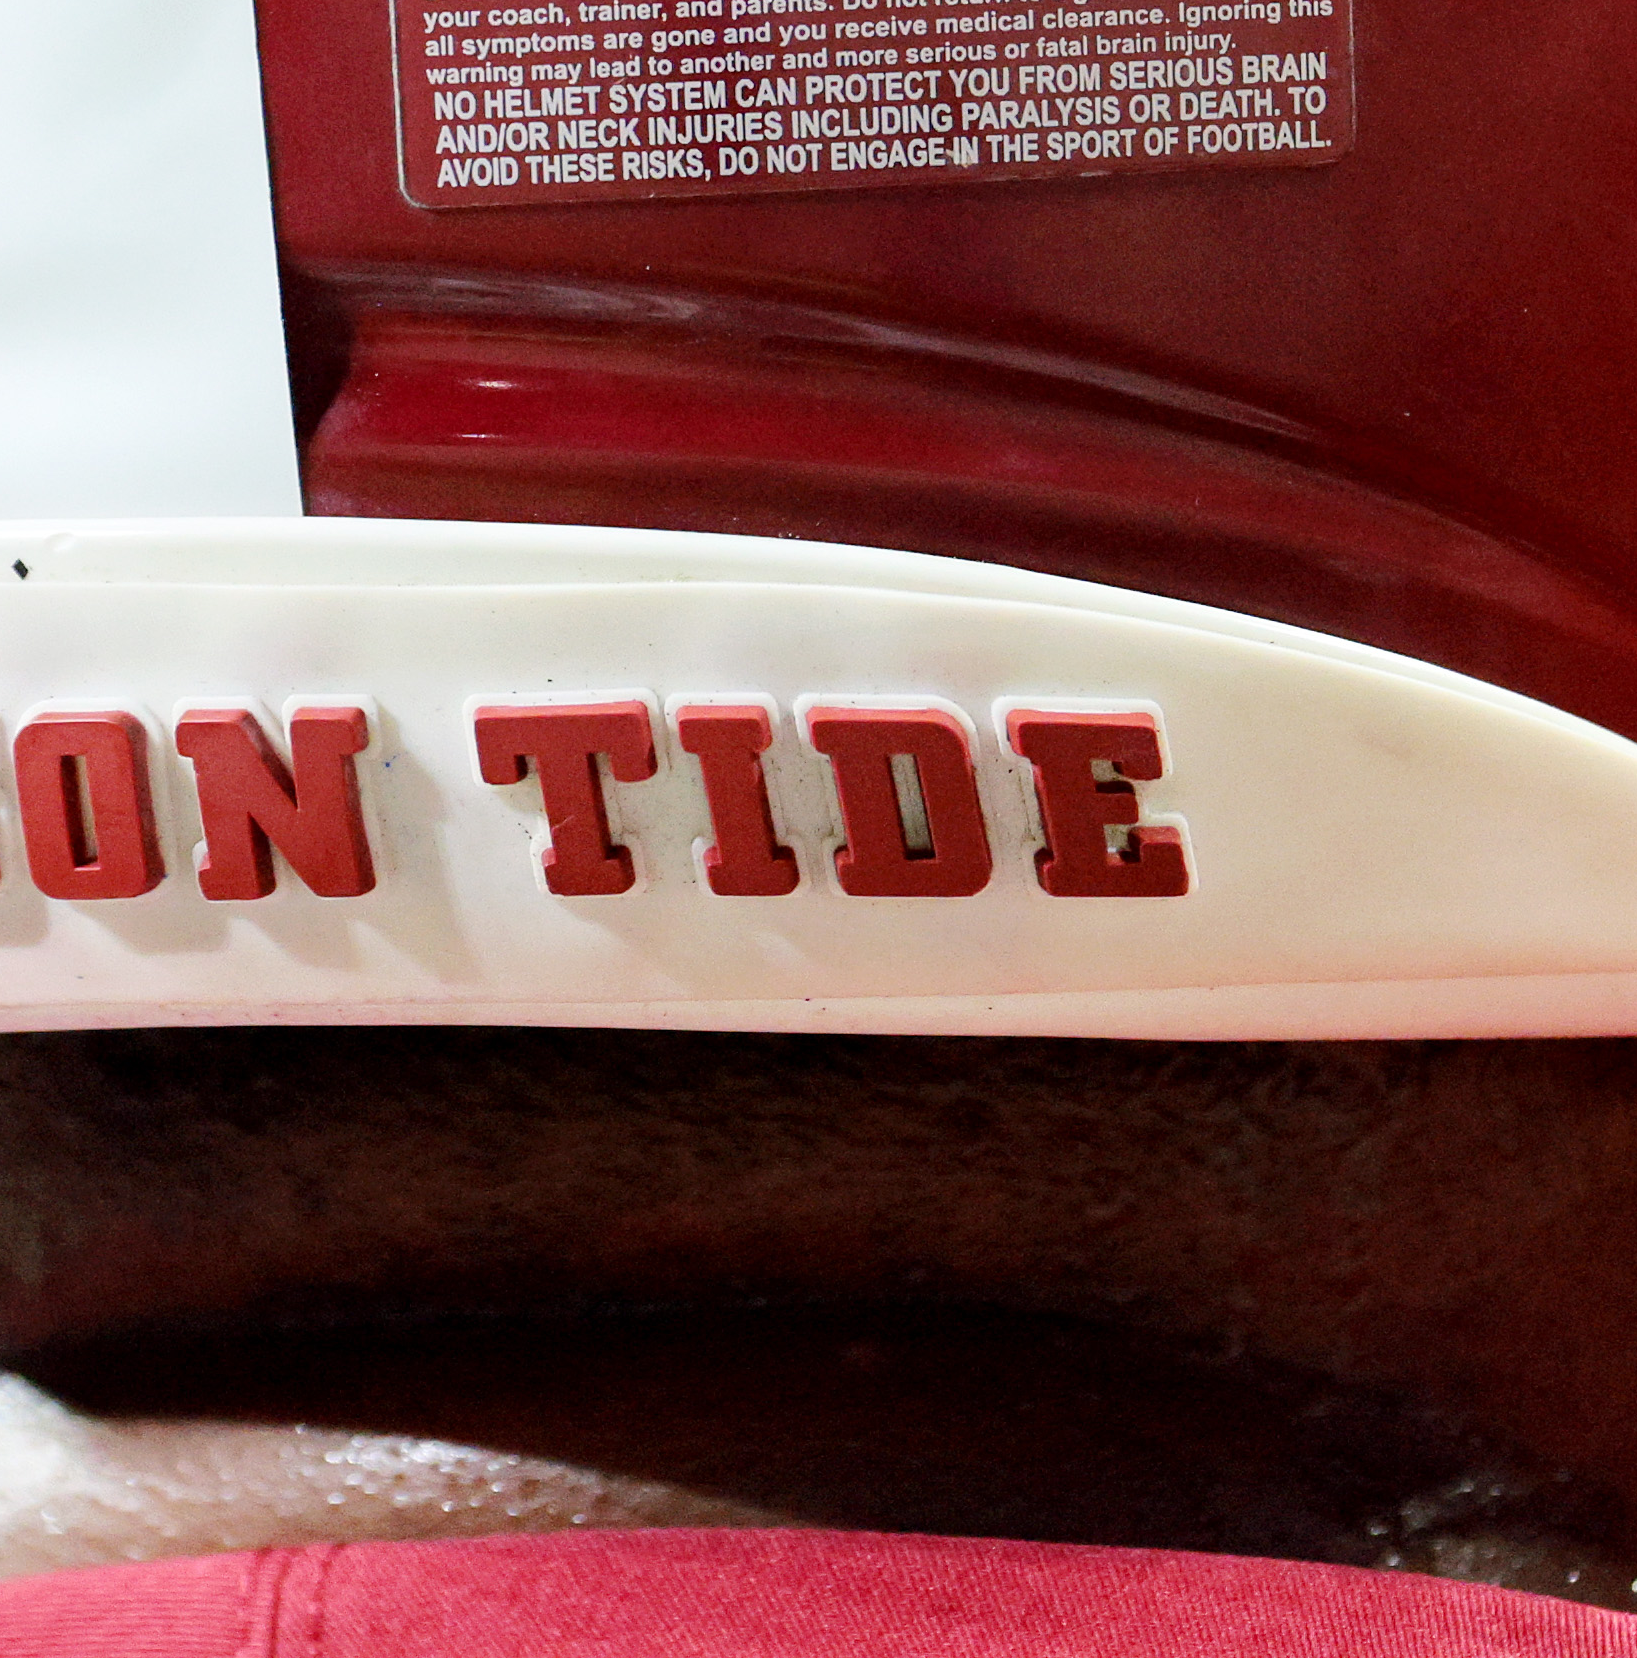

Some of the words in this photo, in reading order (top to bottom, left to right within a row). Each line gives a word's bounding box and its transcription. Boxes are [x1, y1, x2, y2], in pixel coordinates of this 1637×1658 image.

[422, 10, 481, 34] your
[487, 2, 571, 27] coach,
[577, 0, 668, 23] trainer,
[424, 34, 455, 57] all
[461, 32, 596, 60] symptoms
[602, 31, 644, 50] are
[650, 28, 716, 53] gone
[722, 20, 772, 45] and
[778, 23, 827, 47] you
[834, 14, 928, 39] receive
[935, 9, 1035, 34] medical
[1042, 7, 1171, 30] clearance.
[425, 61, 524, 88] warning
[530, 62, 583, 85] may
[589, 54, 641, 79] lead
[647, 55, 673, 77] to
[679, 50, 776, 75] another
[782, 47, 828, 70] and
[835, 48, 899, 68] more
[905, 41, 997, 65] serious
[1004, 42, 1031, 60] or
[1035, 34, 1088, 58] fatal
[1096, 32, 1157, 55] brain
[1164, 29, 1237, 57] injury.
[433, 90, 477, 121] NO
[483, 85, 602, 119] HELMET
[608, 79, 727, 115] SYSTEM
[734, 76, 797, 108] CAN
[805, 69, 942, 105] PROTECT
[947, 66, 1010, 98] YOU
[1018, 62, 1101, 95] FROM
[1109, 56, 1234, 91] SERIOUS
[1241, 51, 1327, 85] BRAIN
[435, 121, 551, 155] AND/OR
[557, 117, 642, 150] NECK
[647, 110, 784, 146] INJURIES
[791, 102, 954, 140] INCLUDING
[961, 95, 1121, 131] PARALYSIS
[1128, 93, 1172, 124] OR
[1179, 87, 1281, 121] DEATH.
[1287, 85, 1327, 115] TO
[436, 156, 519, 189] AVOID
[524, 152, 616, 185] THESE
[621, 147, 712, 182] RISKS,
[718, 145, 760, 177] DO
[766, 142, 823, 174] NOT
[830, 136, 947, 171] ENGAGE
[952, 135, 979, 166] IN
[985, 132, 1040, 163] THE
[1046, 128, 1137, 161] SPORT
[1143, 126, 1180, 157] OF
[1187, 119, 1332, 154] FOOTBALL.
[474, 701, 1190, 897] TIDE
